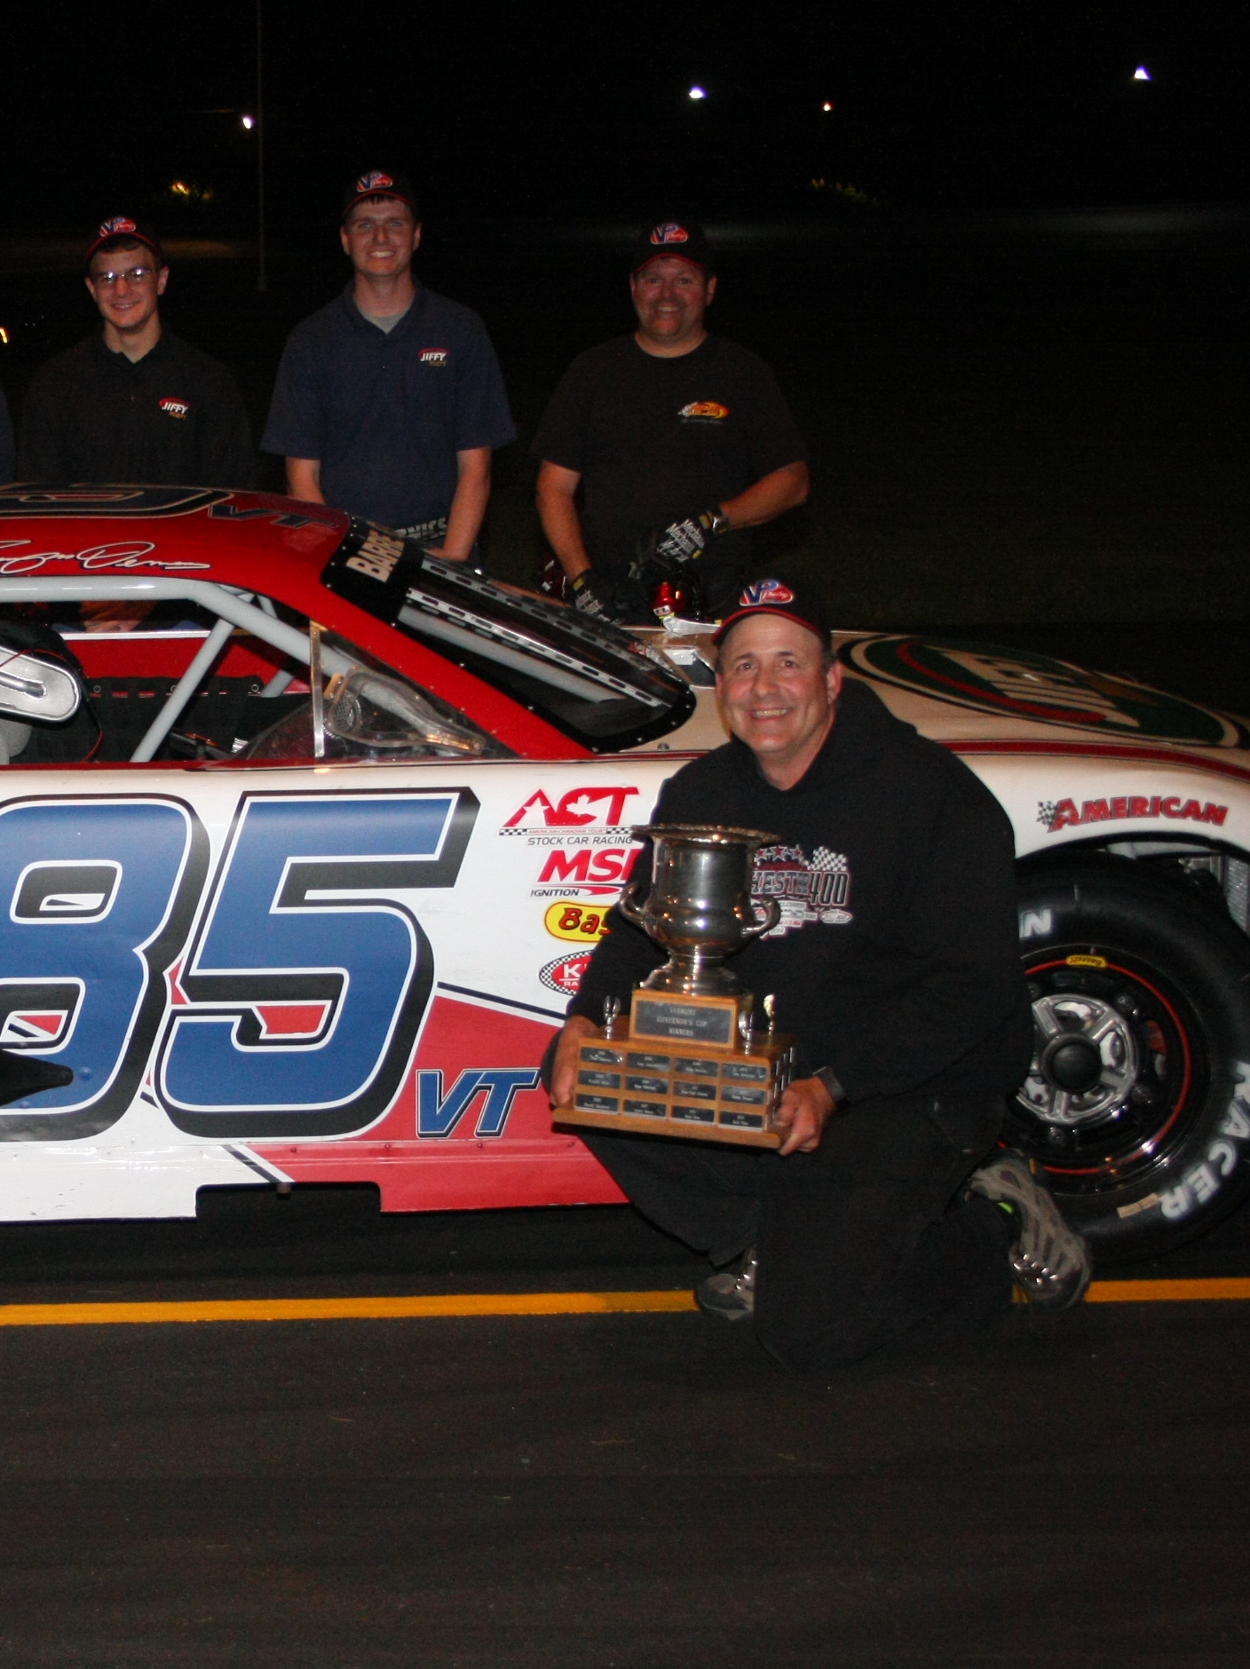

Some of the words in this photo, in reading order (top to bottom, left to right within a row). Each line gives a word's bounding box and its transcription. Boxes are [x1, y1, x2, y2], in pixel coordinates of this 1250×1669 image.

[420, 352, 447, 362] JIFFY
[161, 401, 189, 414] JIFFY
[742, 579, 780, 604] VP
[502, 786, 640, 828] ACT
[1047, 796, 1228, 833] AMERICAN
[527, 837, 564, 846] STOCK
[566, 836, 589, 845] CAR
[592, 836, 633, 845] RACING
[530, 888, 580, 897] IGNITION
[808, 870, 850, 907] 400
[415, 1068, 541, 1139] VT
